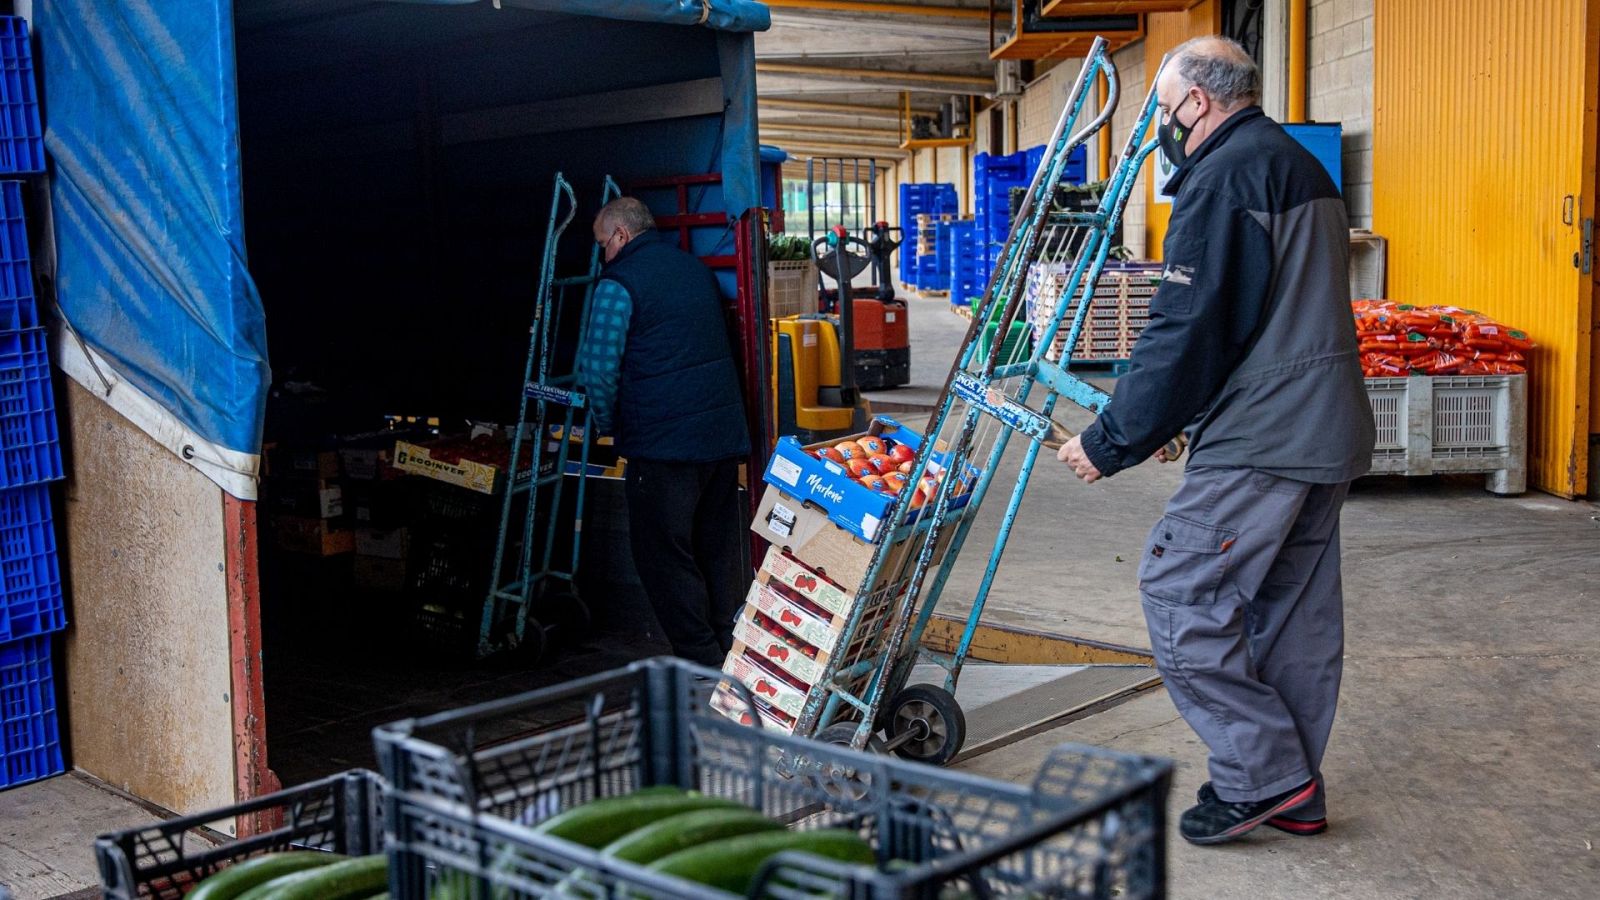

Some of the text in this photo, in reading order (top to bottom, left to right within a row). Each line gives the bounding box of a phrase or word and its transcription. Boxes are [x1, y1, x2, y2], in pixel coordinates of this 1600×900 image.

[409, 456, 465, 476] ECOINVER
[517, 462, 554, 479] ECOVER
[806, 474, 843, 503] Marlene
